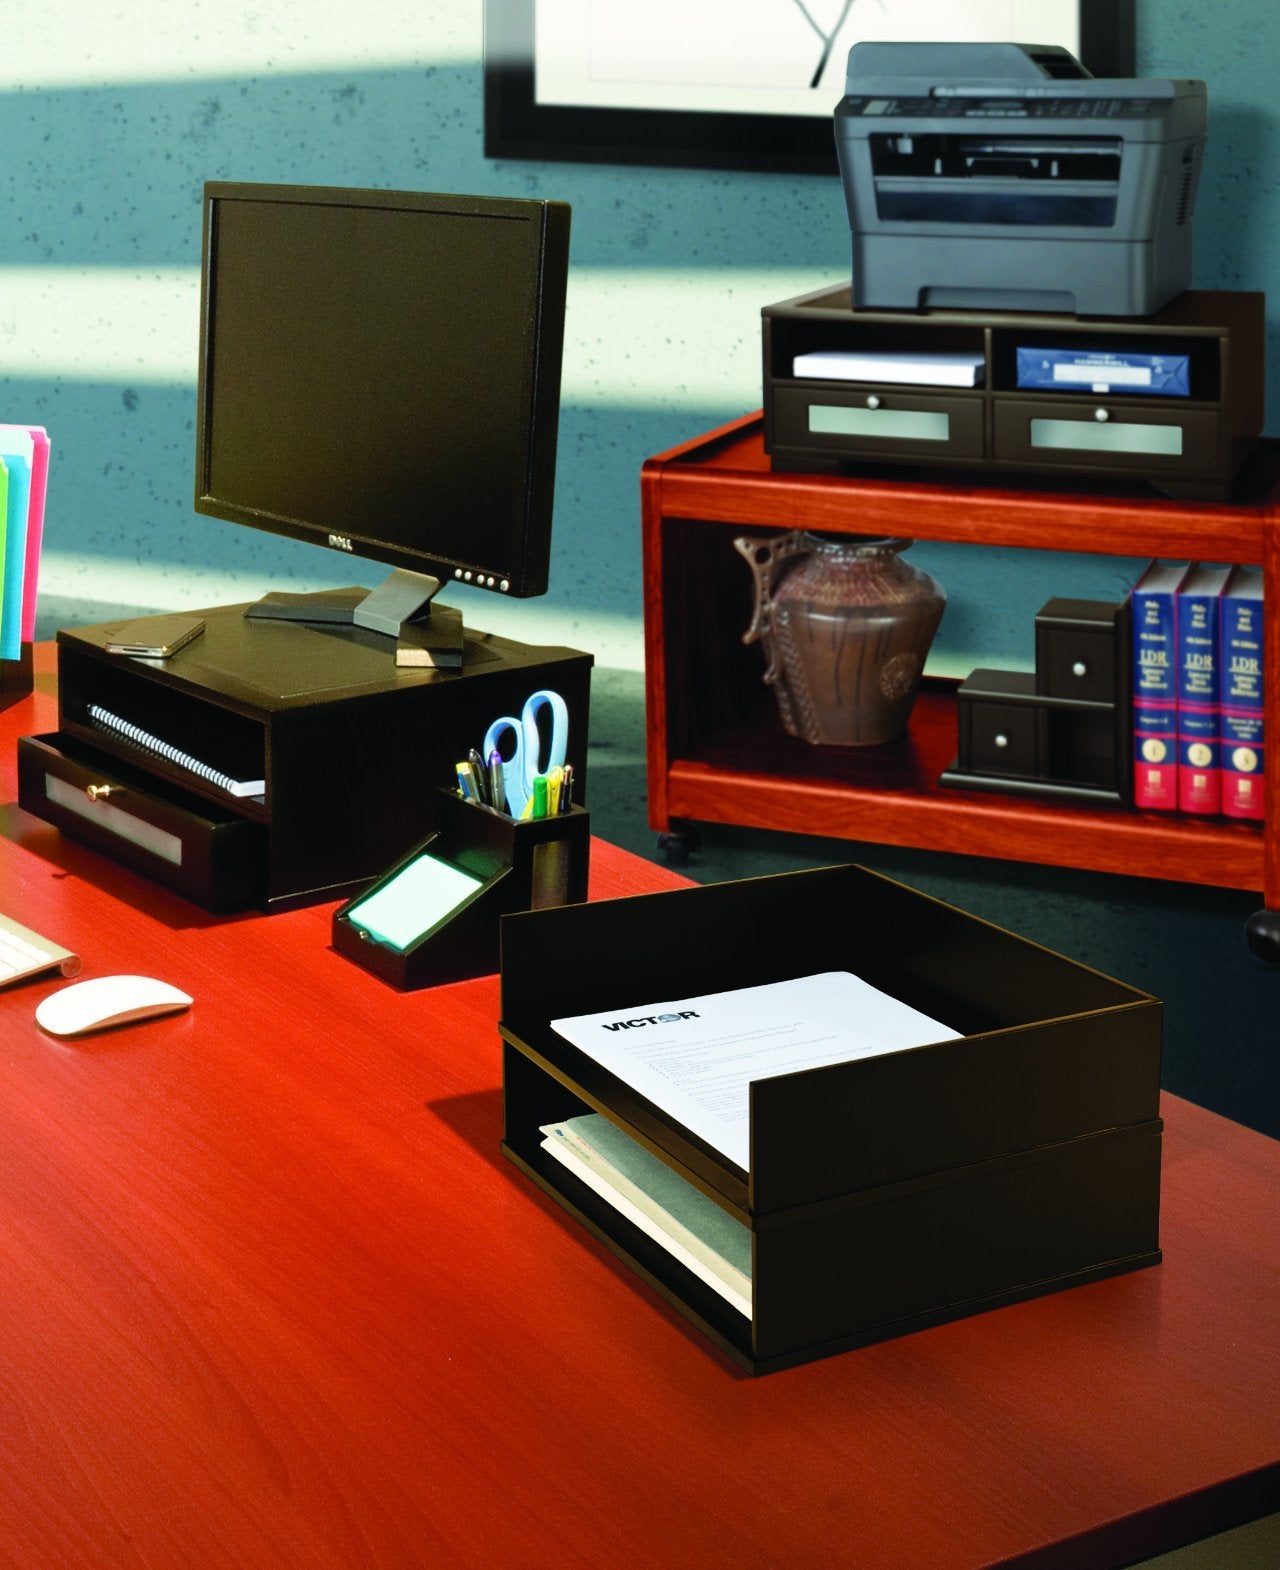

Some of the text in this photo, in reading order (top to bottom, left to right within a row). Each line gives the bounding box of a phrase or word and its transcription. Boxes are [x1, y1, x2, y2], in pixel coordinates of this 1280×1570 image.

[329, 534, 353, 551] DELL
[1140, 649, 1166, 664] LDR
[1186, 653, 1212, 669] LDR
[1232, 656, 1258, 673] LDR
[601, 1010, 701, 1032] VICTOR
